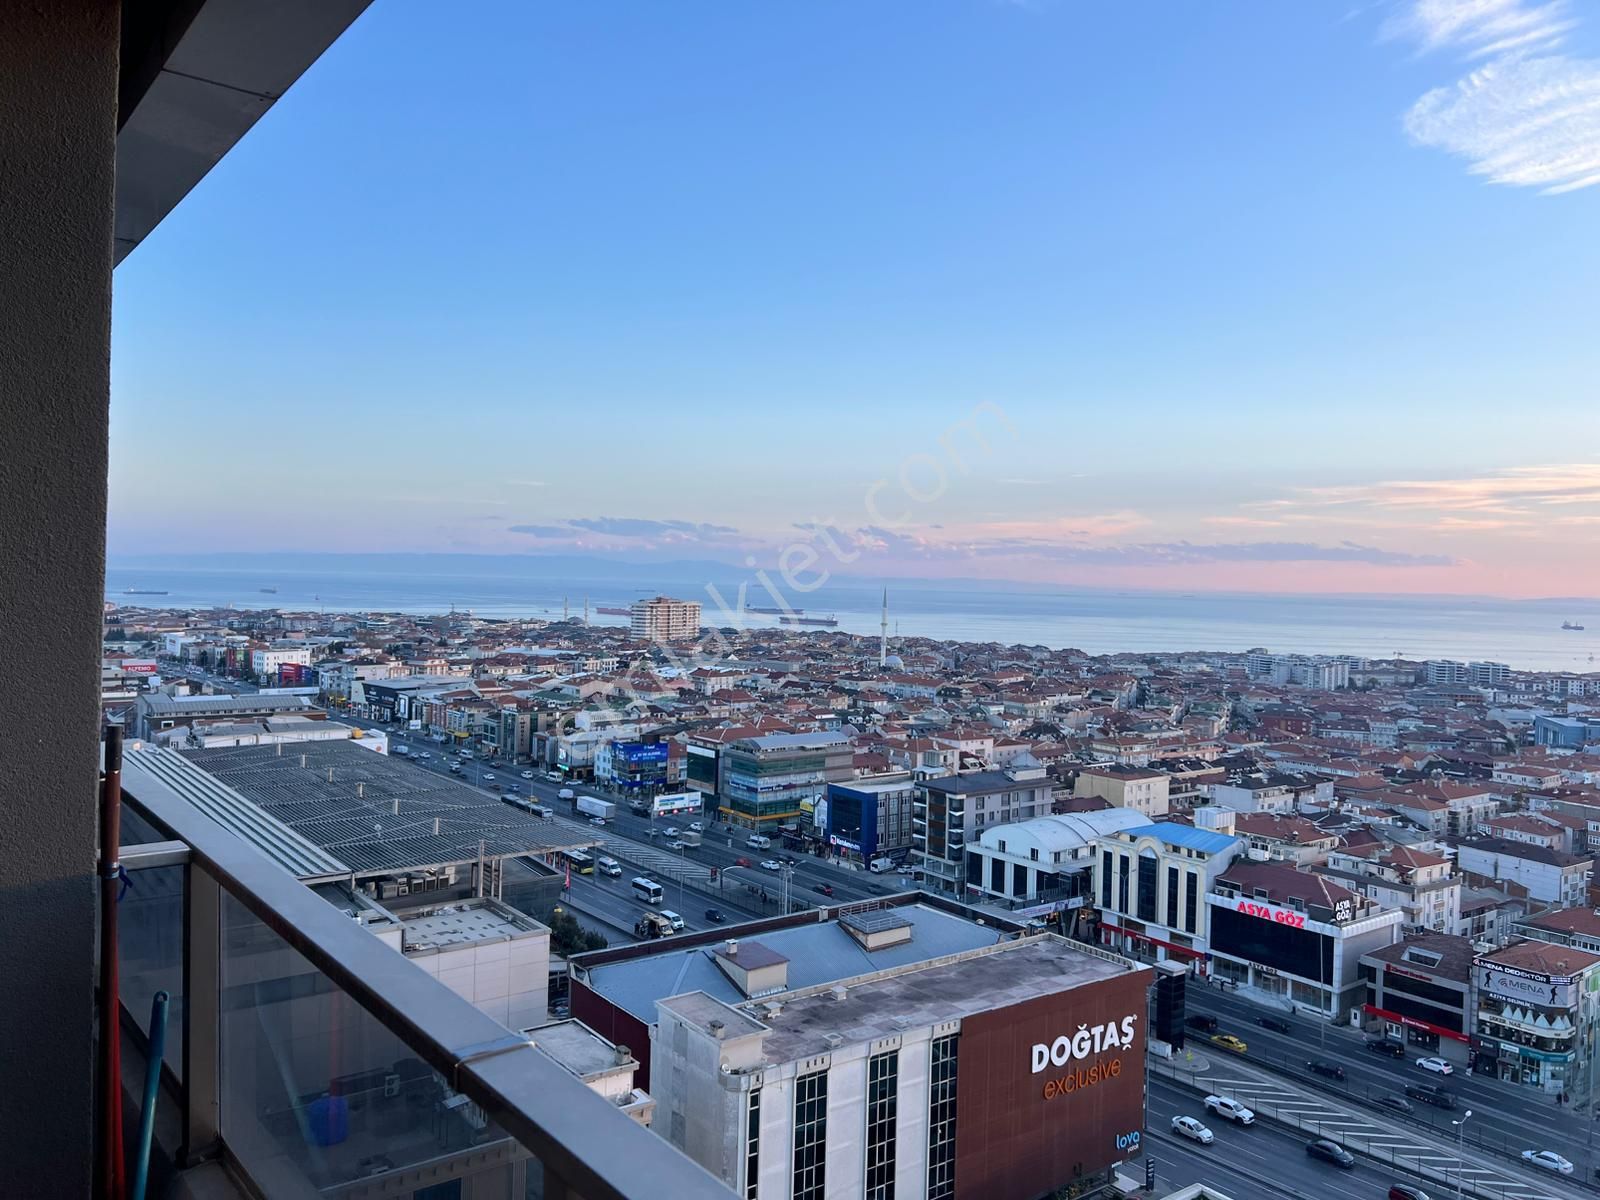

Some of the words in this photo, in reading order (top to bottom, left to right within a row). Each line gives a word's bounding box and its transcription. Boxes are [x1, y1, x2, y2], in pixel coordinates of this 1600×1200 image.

[1335, 899, 1351, 912] ASYA
[1237, 901, 1271, 920] ASYA
[1275, 911, 1304, 928] GÖZ
[1336, 910, 1350, 921] GÖZ
[1480, 961, 1504, 972] MENA
[1509, 980, 1545, 994] MENA
[1031, 1015, 1135, 1074] DOĞTAŞ
[1044, 1058, 1121, 1100] exclusive
[1116, 1131, 1140, 1149] lova
